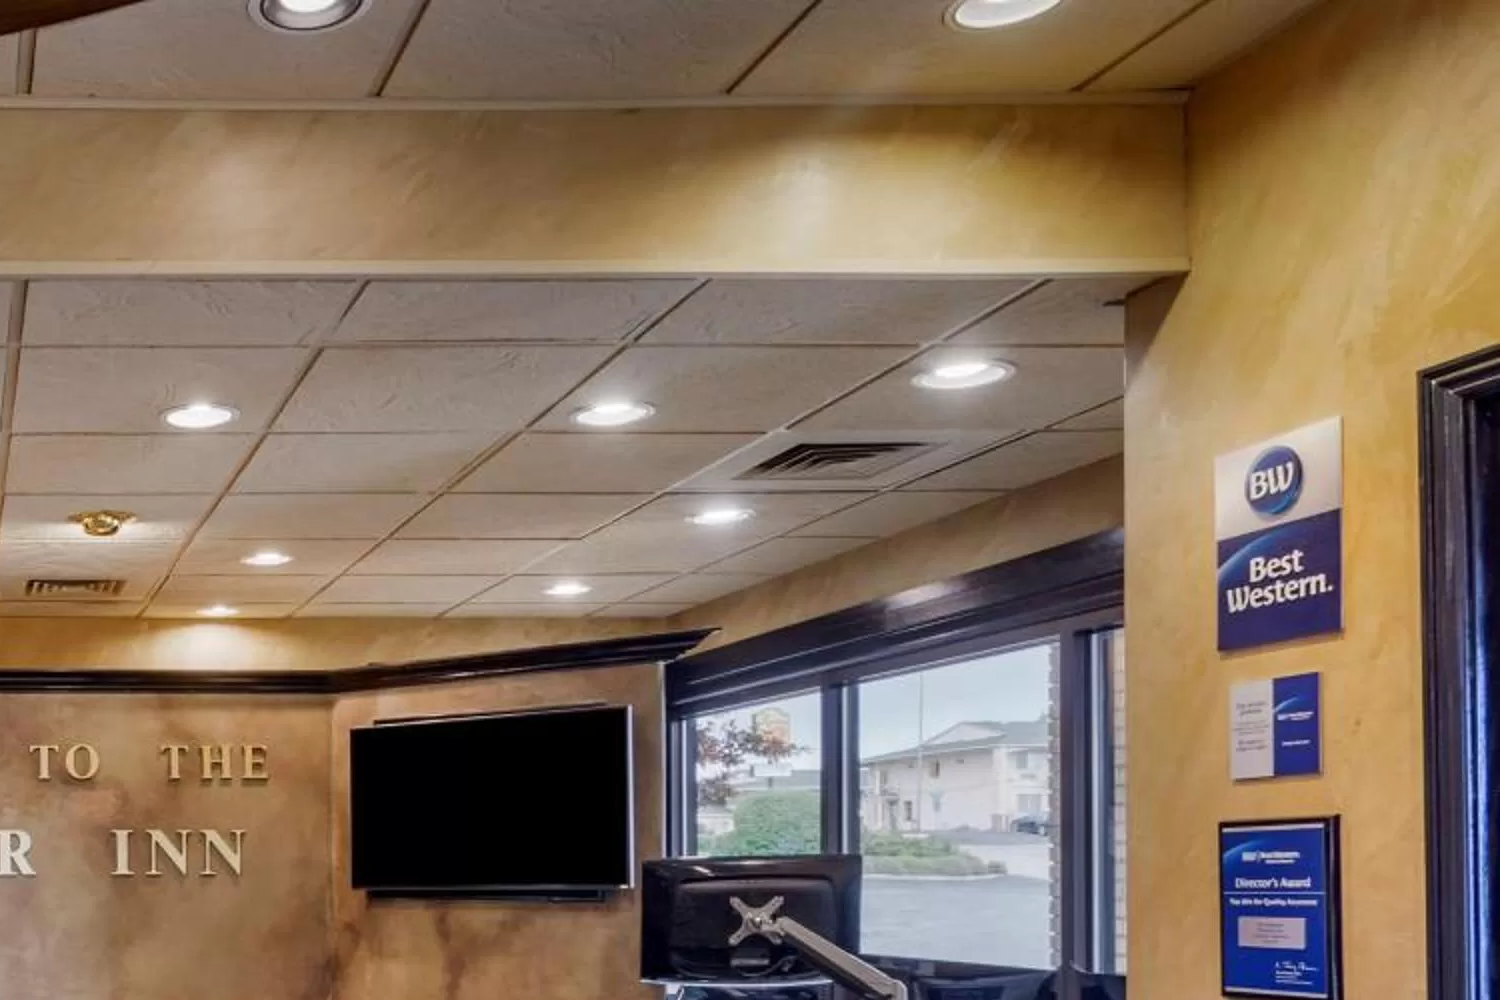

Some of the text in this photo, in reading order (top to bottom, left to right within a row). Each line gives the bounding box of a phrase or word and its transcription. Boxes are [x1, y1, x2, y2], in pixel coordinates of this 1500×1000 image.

[1250, 461, 1294, 501] BW
[1250, 549, 1304, 583] Best
[29, 743, 99, 781] TO
[160, 743, 269, 783] THE
[110, 828, 246, 877] INN
